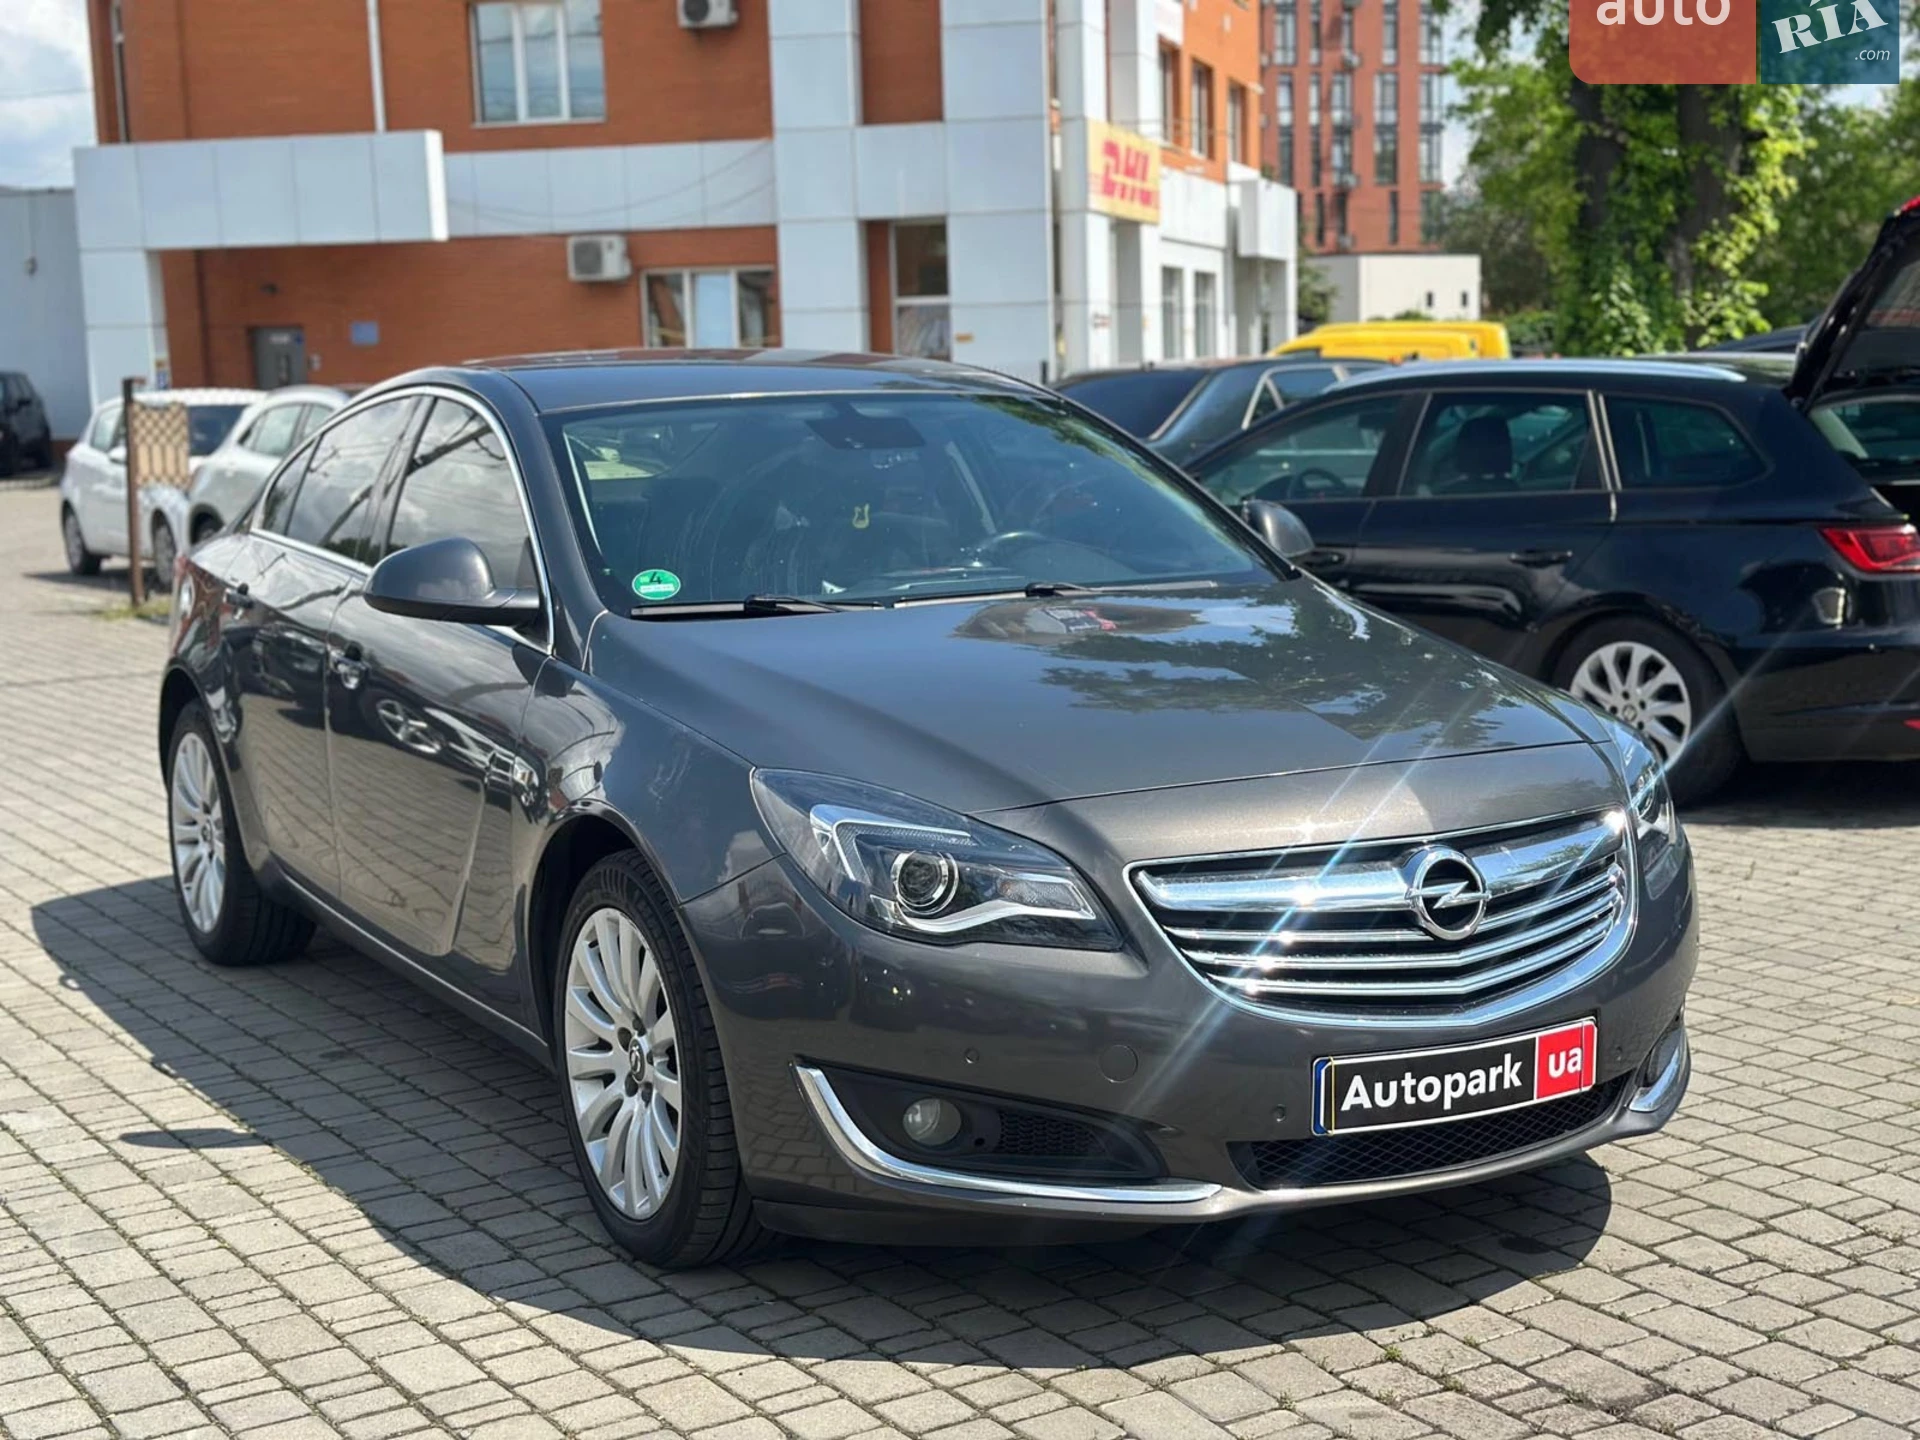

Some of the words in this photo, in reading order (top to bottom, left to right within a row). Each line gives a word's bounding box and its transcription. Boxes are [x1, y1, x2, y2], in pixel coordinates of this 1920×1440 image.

[1102, 140, 1153, 206] DHL
[649, 571, 662, 584] 4
[1340, 1053, 1522, 1110] Autopark
[1547, 1045, 1583, 1078] ua
